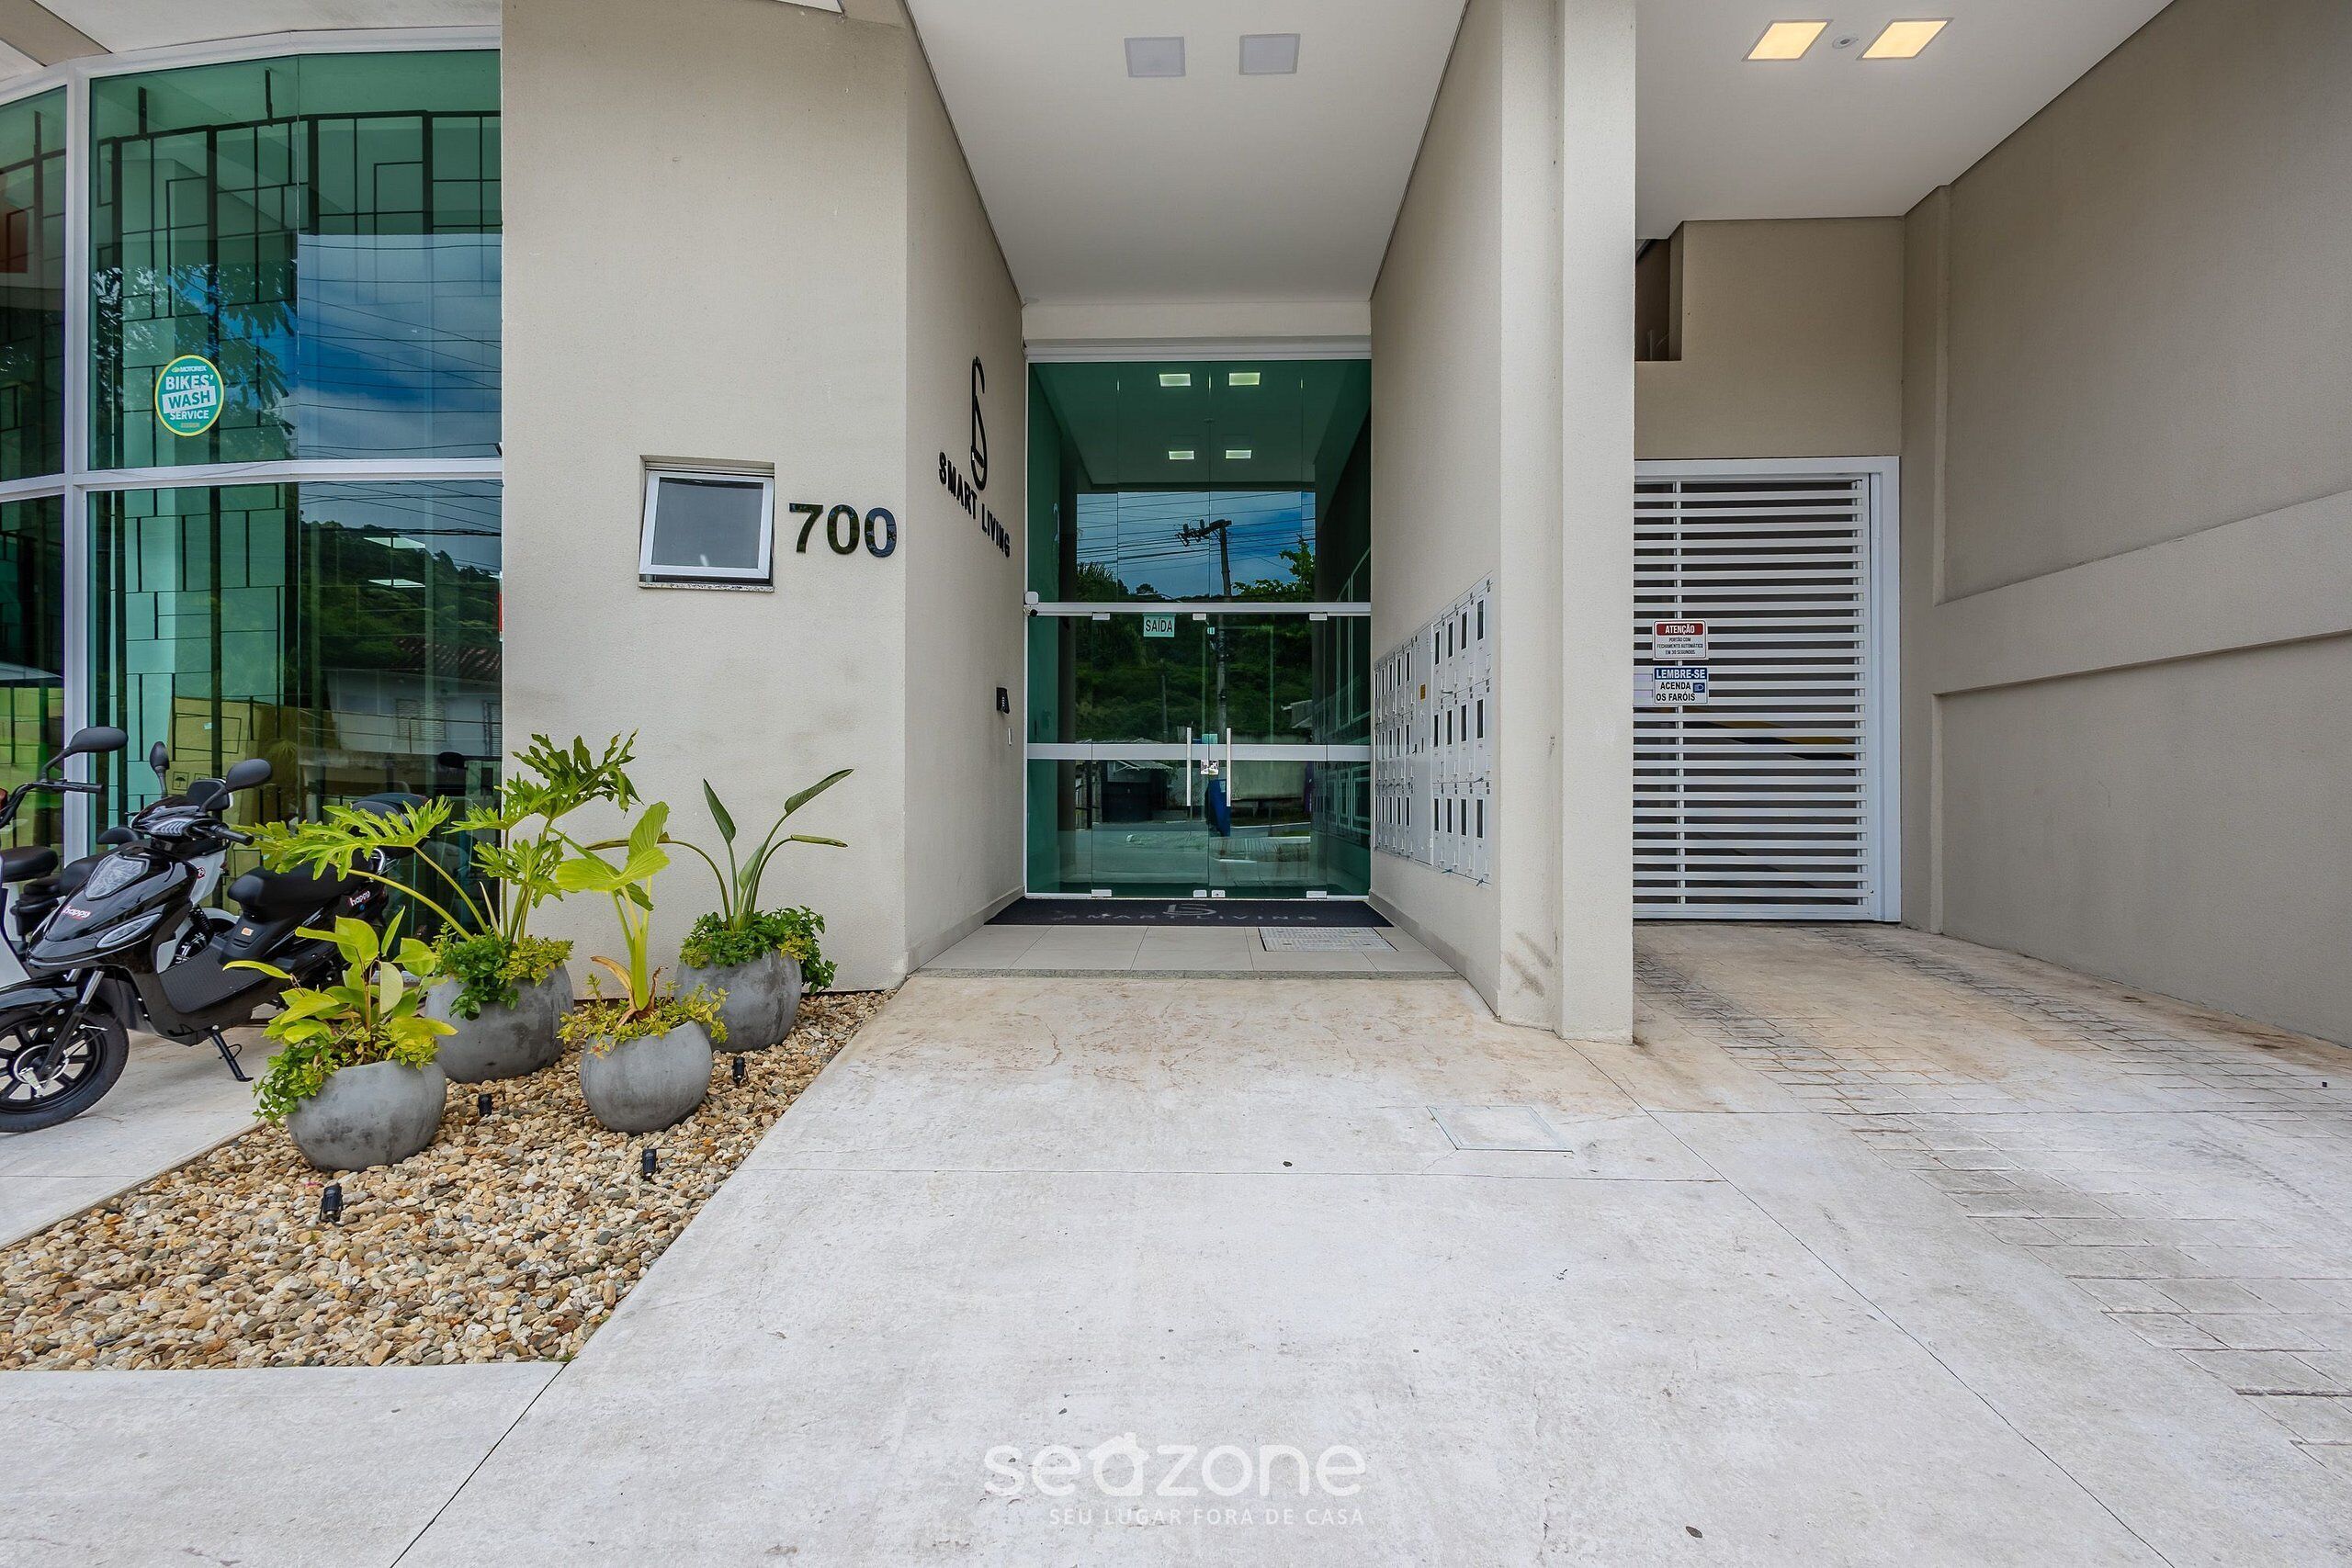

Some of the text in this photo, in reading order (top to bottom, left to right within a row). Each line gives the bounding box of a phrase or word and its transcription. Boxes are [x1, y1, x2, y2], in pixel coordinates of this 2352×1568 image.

[165, 374, 213, 390] BIKES'
[168, 389, 210, 409] WASH
[169, 410, 209, 421] SERVICE
[938, 451, 1011, 558] SMART LIVING
[789, 502, 897, 558] 700
[1145, 617, 1172, 632] SAÍDA
[1665, 624, 1695, 635] ATENÇÃO
[1656, 669, 1705, 678] LEMBRE-SE
[1660, 682, 1690, 690] ACENDA
[1656, 691, 1695, 701] OS FARÓIS
[349, 890, 371, 906] happy
[62, 905, 91, 919] happy
